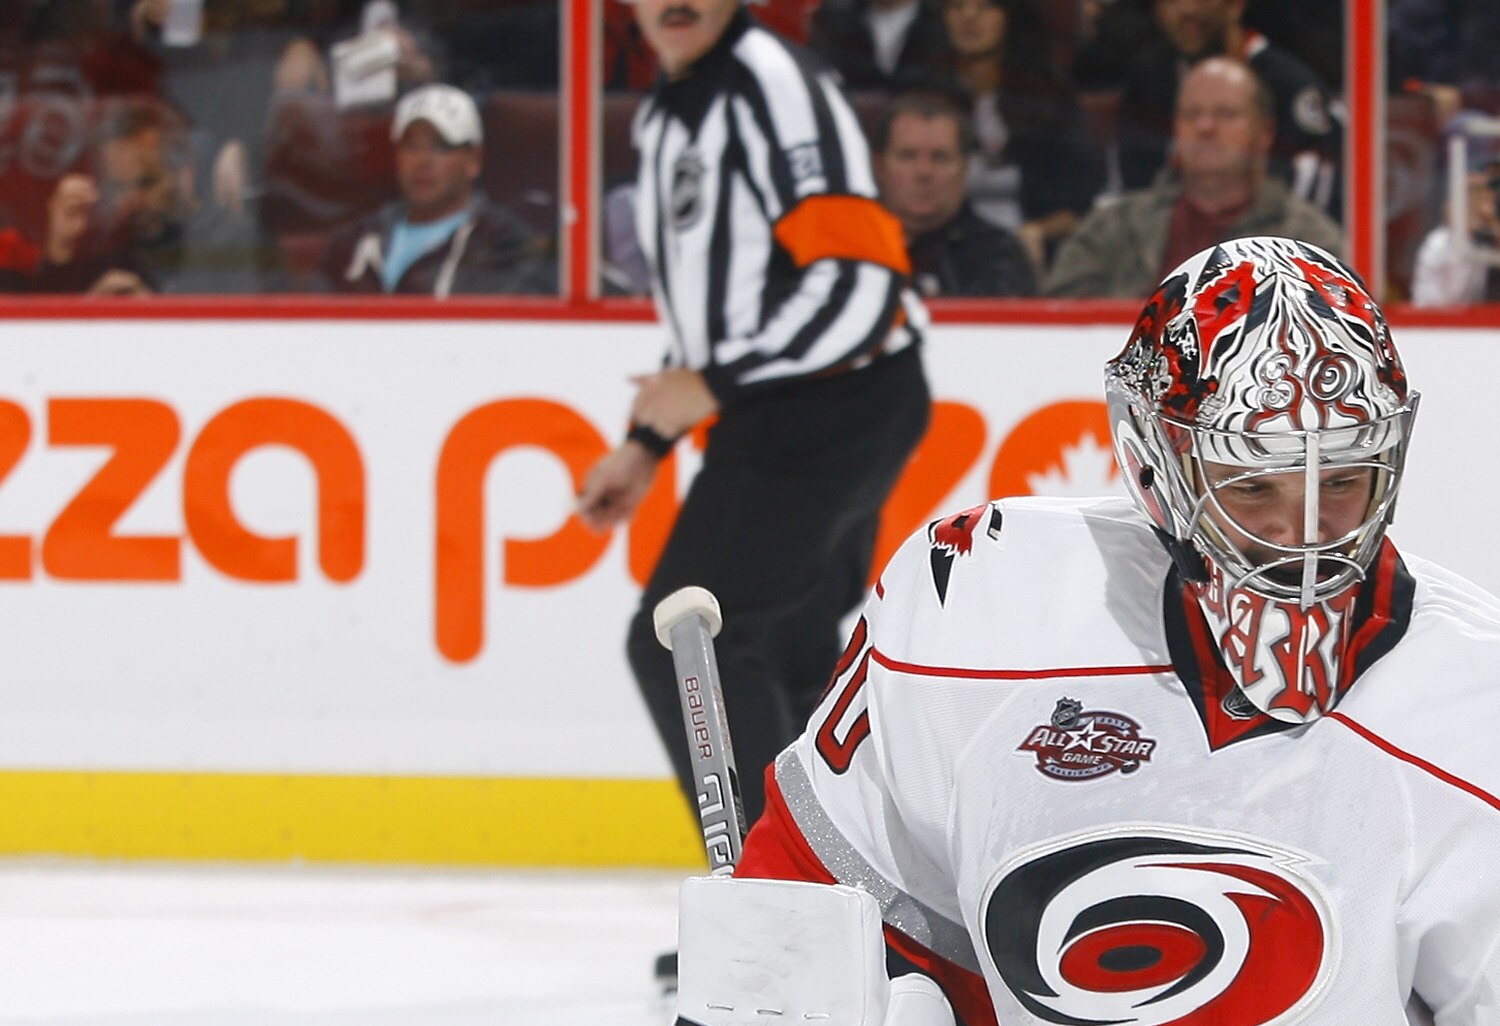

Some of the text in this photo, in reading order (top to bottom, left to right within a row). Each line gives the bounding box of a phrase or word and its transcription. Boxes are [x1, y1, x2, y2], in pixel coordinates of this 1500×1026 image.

[1028, 728, 1153, 756] ALL STAR
[1061, 752, 1104, 766] GAME
